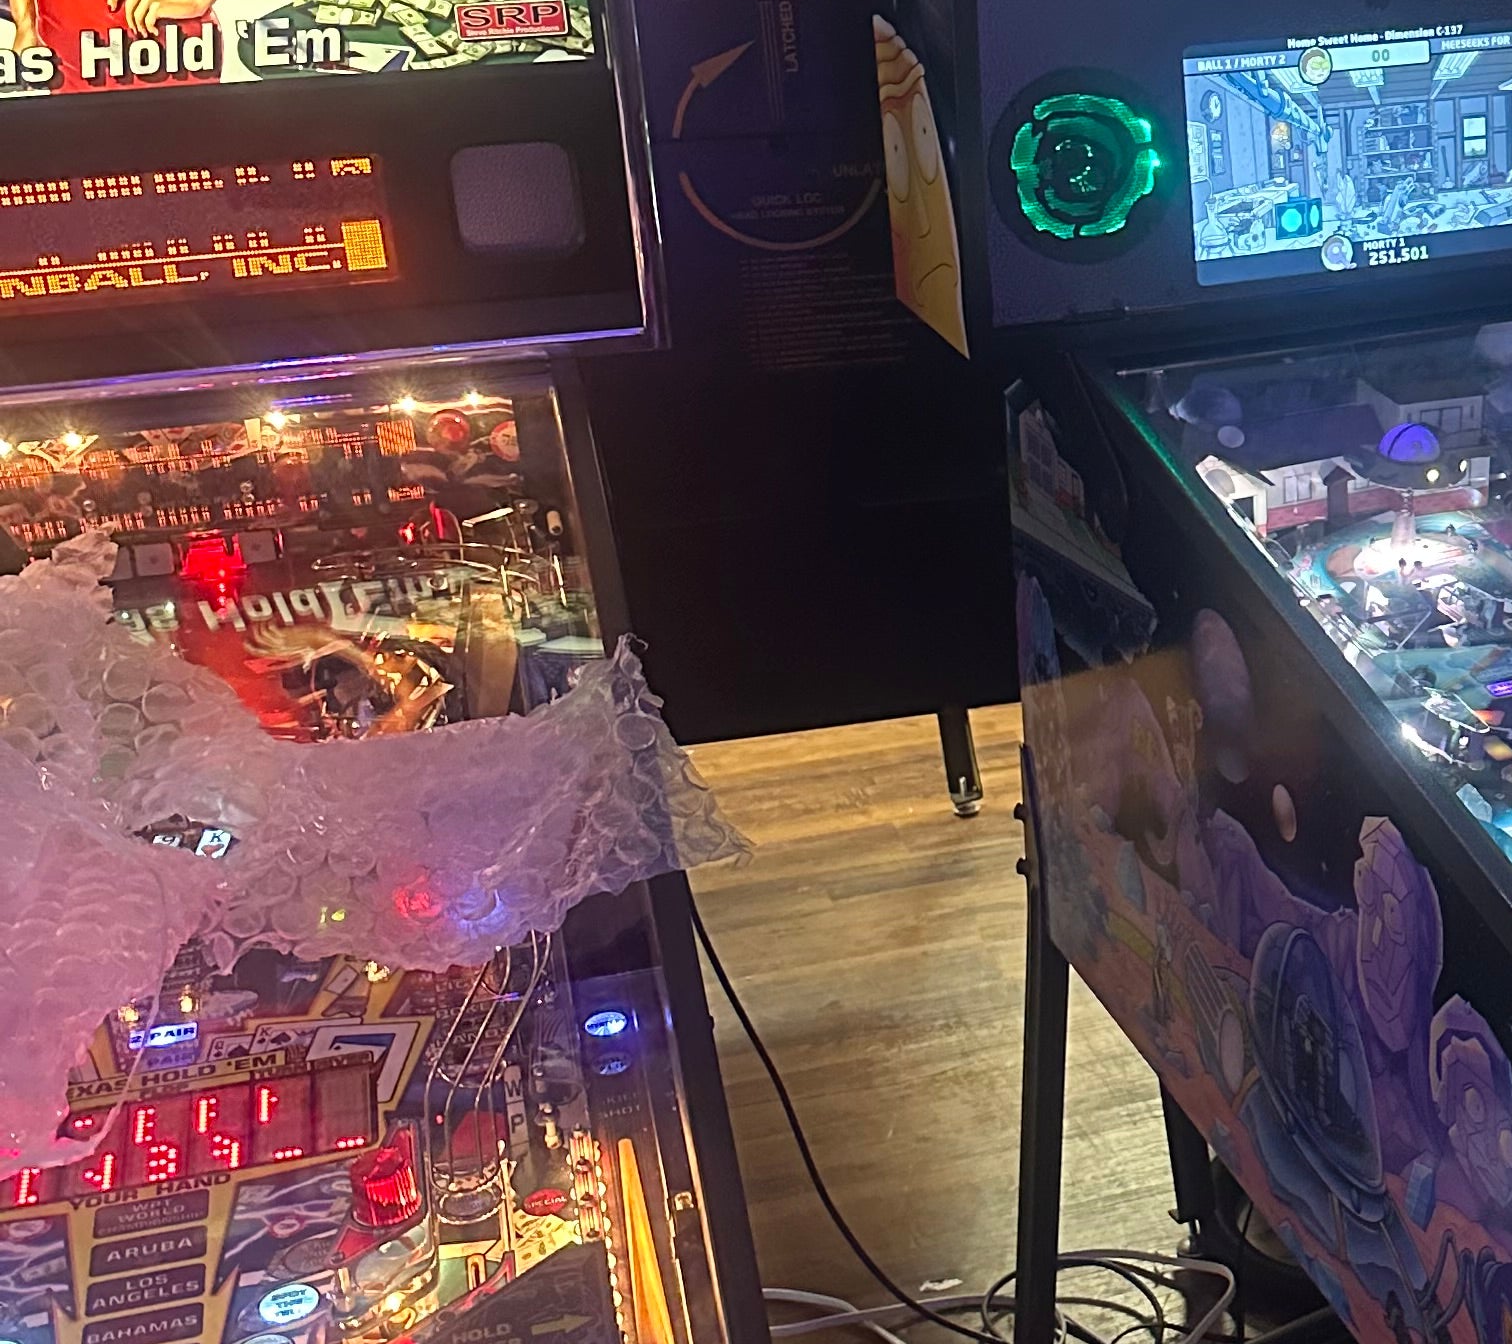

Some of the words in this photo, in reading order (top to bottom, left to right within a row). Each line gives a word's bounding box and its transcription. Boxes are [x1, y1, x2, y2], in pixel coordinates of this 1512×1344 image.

[463, 2, 560, 27] SRP
[80, 22, 214, 80] Hold
[236, 18, 342, 68] 'Em
[1491, 35, 1511, 46] FOR
[1197, 59, 1223, 71] BALL
[1240, 56, 1277, 68] MORTY
[1363, 238, 1398, 252] MORTY
[1369, 245, 1429, 266] 251,501
[149, 1025, 197, 1042] PAIR
[140, 1063, 217, 1087] HOLD
[67, 1189, 139, 1211] YOUR
[156, 1173, 231, 1195] HAND
[118, 1205, 185, 1223] WORLD
[106, 1236, 193, 1263] ARUBA
[125, 1273, 168, 1291] LOS
[92, 1280, 200, 1310] ANGELES
[86, 1314, 198, 1344] BAHAMAS
[451, 1323, 512, 1344] HOLD
